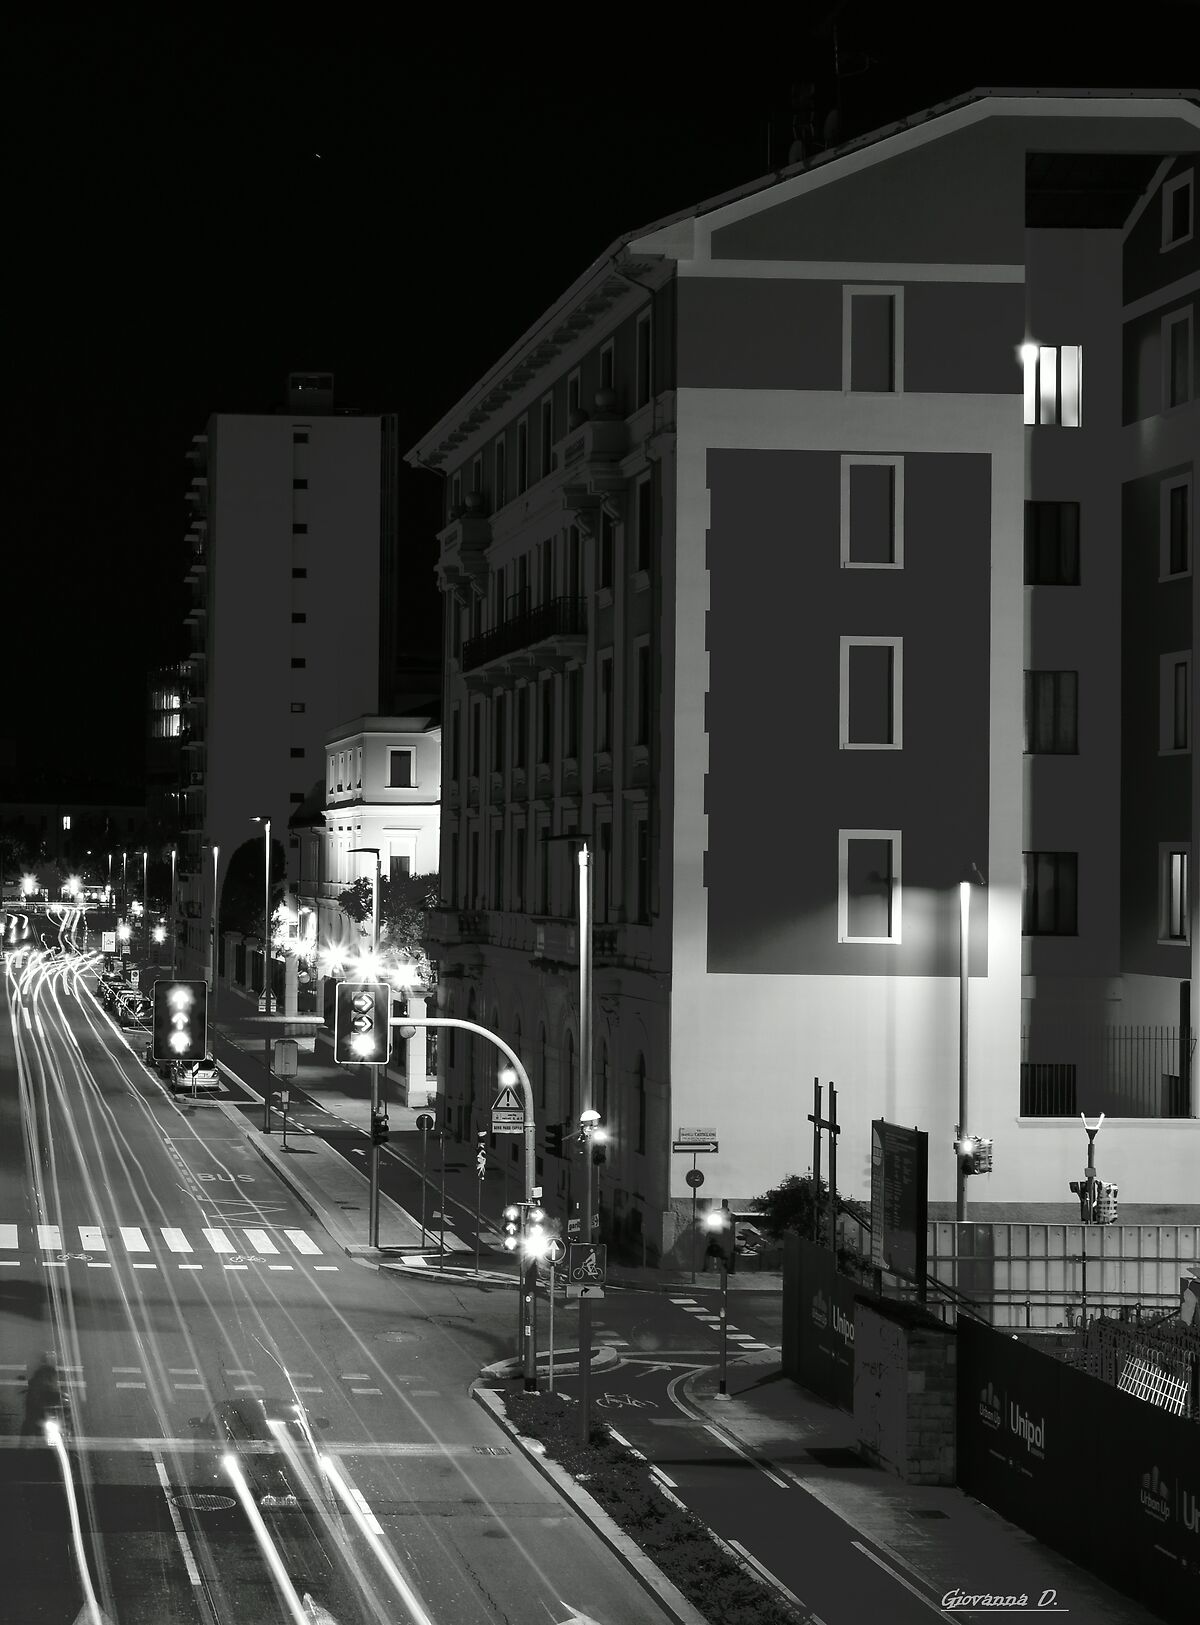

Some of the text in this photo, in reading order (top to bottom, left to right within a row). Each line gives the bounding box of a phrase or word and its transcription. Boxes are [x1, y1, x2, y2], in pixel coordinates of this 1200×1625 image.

[832, 1304, 855, 1343] Unipo
[1010, 1400, 1045, 1452] Unipol
[1140, 1488, 1160, 1512] Urban
[1160, 1499, 1170, 1520] Up
